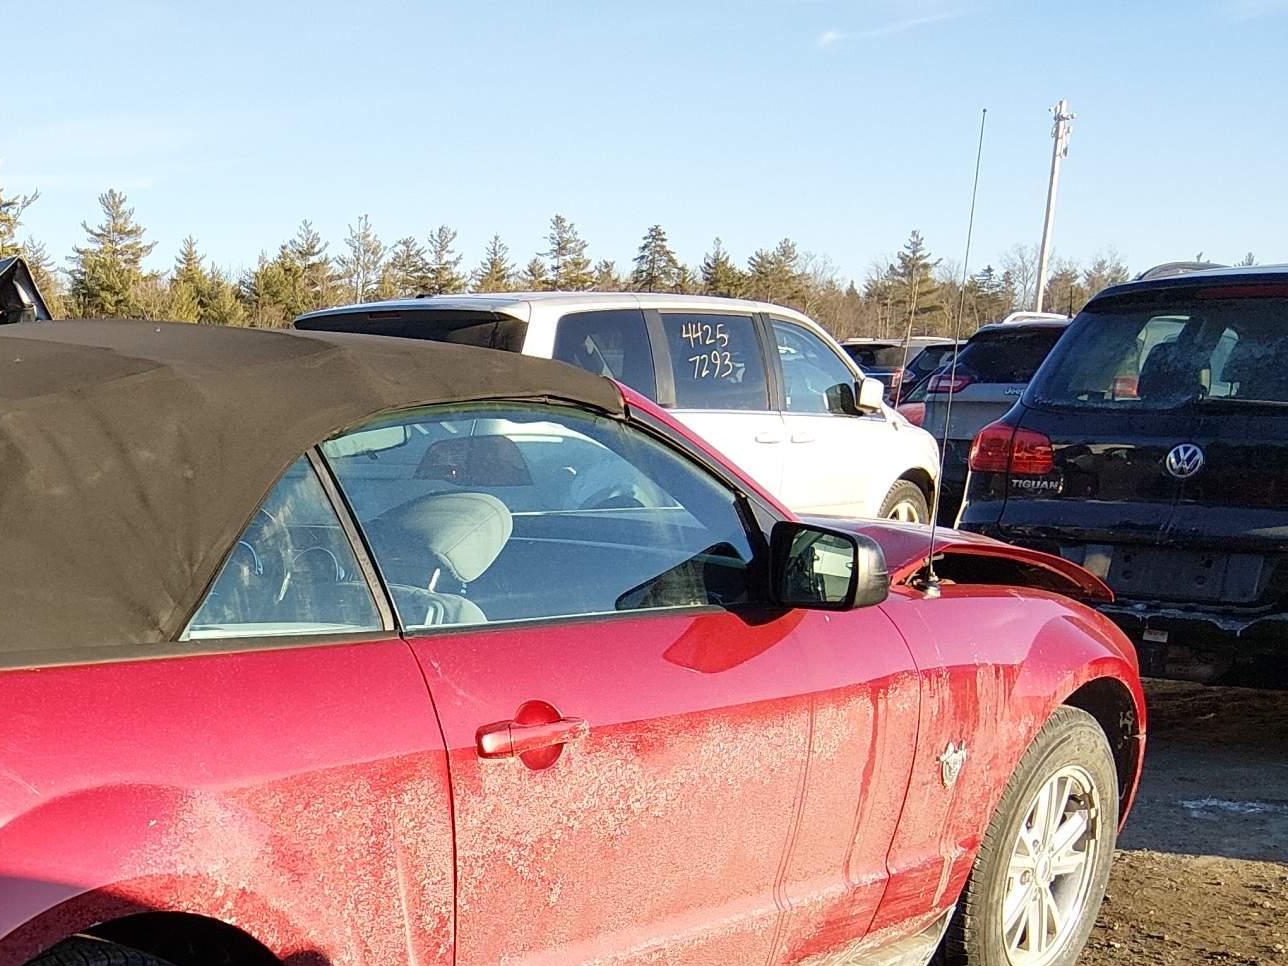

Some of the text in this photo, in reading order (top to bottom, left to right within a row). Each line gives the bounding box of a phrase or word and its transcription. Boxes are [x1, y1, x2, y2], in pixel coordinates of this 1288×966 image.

[682, 322, 729, 349] 4425
[688, 350, 733, 380] 7293
[1011, 479, 1059, 490] TIGUAN
